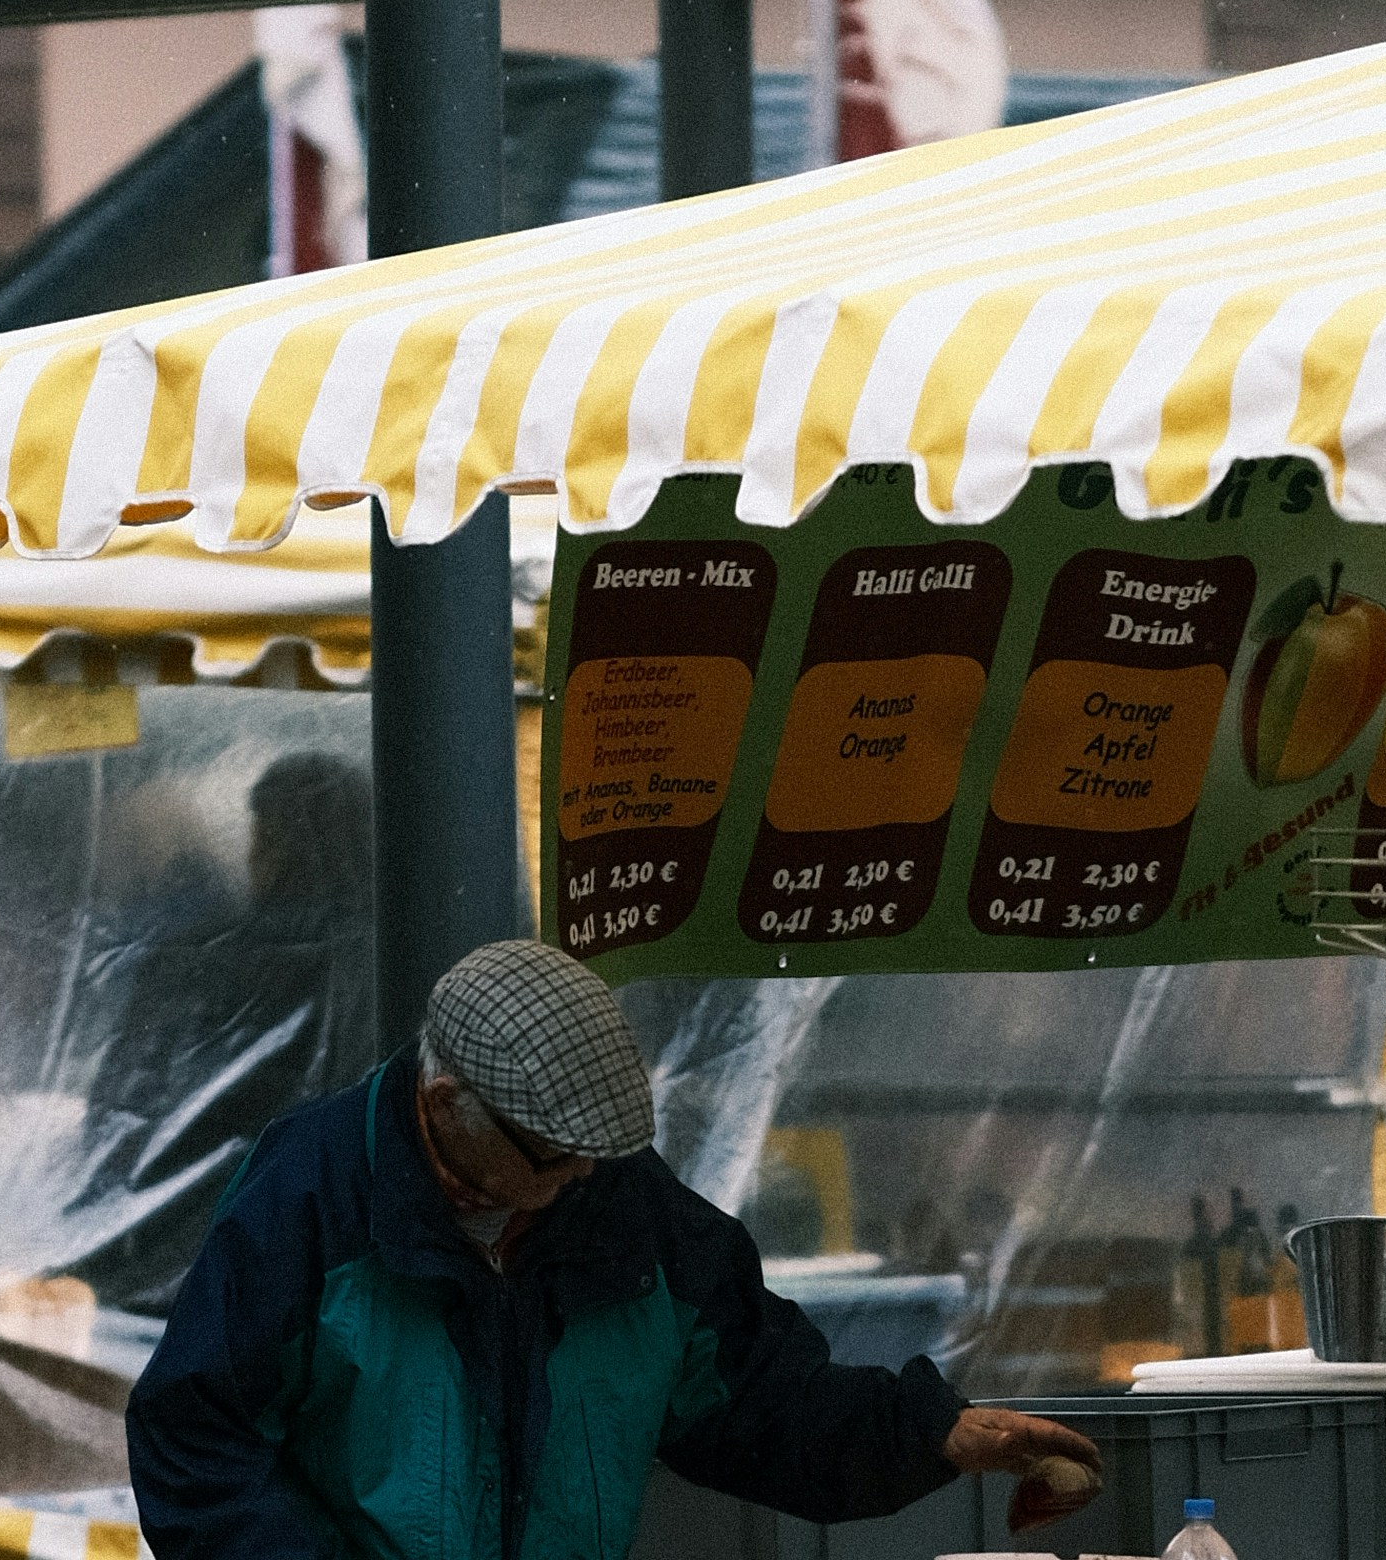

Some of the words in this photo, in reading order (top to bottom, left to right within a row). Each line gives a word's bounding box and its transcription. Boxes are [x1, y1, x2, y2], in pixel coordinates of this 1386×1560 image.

[885, 464, 902, 485] €
[593, 562, 680, 590] Beeren
[700, 560, 755, 588] Mix
[852, 569, 915, 597] Halli
[918, 563, 976, 591] Galli
[1104, 613, 1197, 646] Drink
[604, 661, 683, 684] Erdbeer,
[581, 690, 701, 715] Johannisbeer,
[849, 694, 916, 719] Ananas
[1083, 692, 1174, 731] Orange
[594, 716, 670, 740] Himbeer,
[593, 745, 674, 768] Brombeer
[839, 733, 907, 762] Orange
[1083, 733, 1158, 767] Apfel
[648, 773, 717, 795] Banane
[1059, 768, 1153, 798] Zitrone
[581, 808, 608, 827] oder
[613, 800, 672, 823] Orange
[1242, 772, 1355, 873] gesund
[609, 861, 655, 891] 2,30
[659, 860, 680, 884] €
[772, 864, 825, 895] 0,2l
[843, 860, 891, 889] 2,30
[895, 860, 915, 883] €
[998, 856, 1056, 883] 0,2l
[1081, 862, 1140, 890] 2,30
[1143, 860, 1162, 883] €
[602, 906, 642, 937] 3,50
[644, 903, 663, 926] €
[760, 906, 814, 937] 0,4l
[826, 903, 875, 934] 3,50
[879, 902, 899, 925] €
[988, 897, 1046, 925] 0,4l
[1062, 902, 1121, 929] 3,50
[1125, 901, 1146, 923] €
